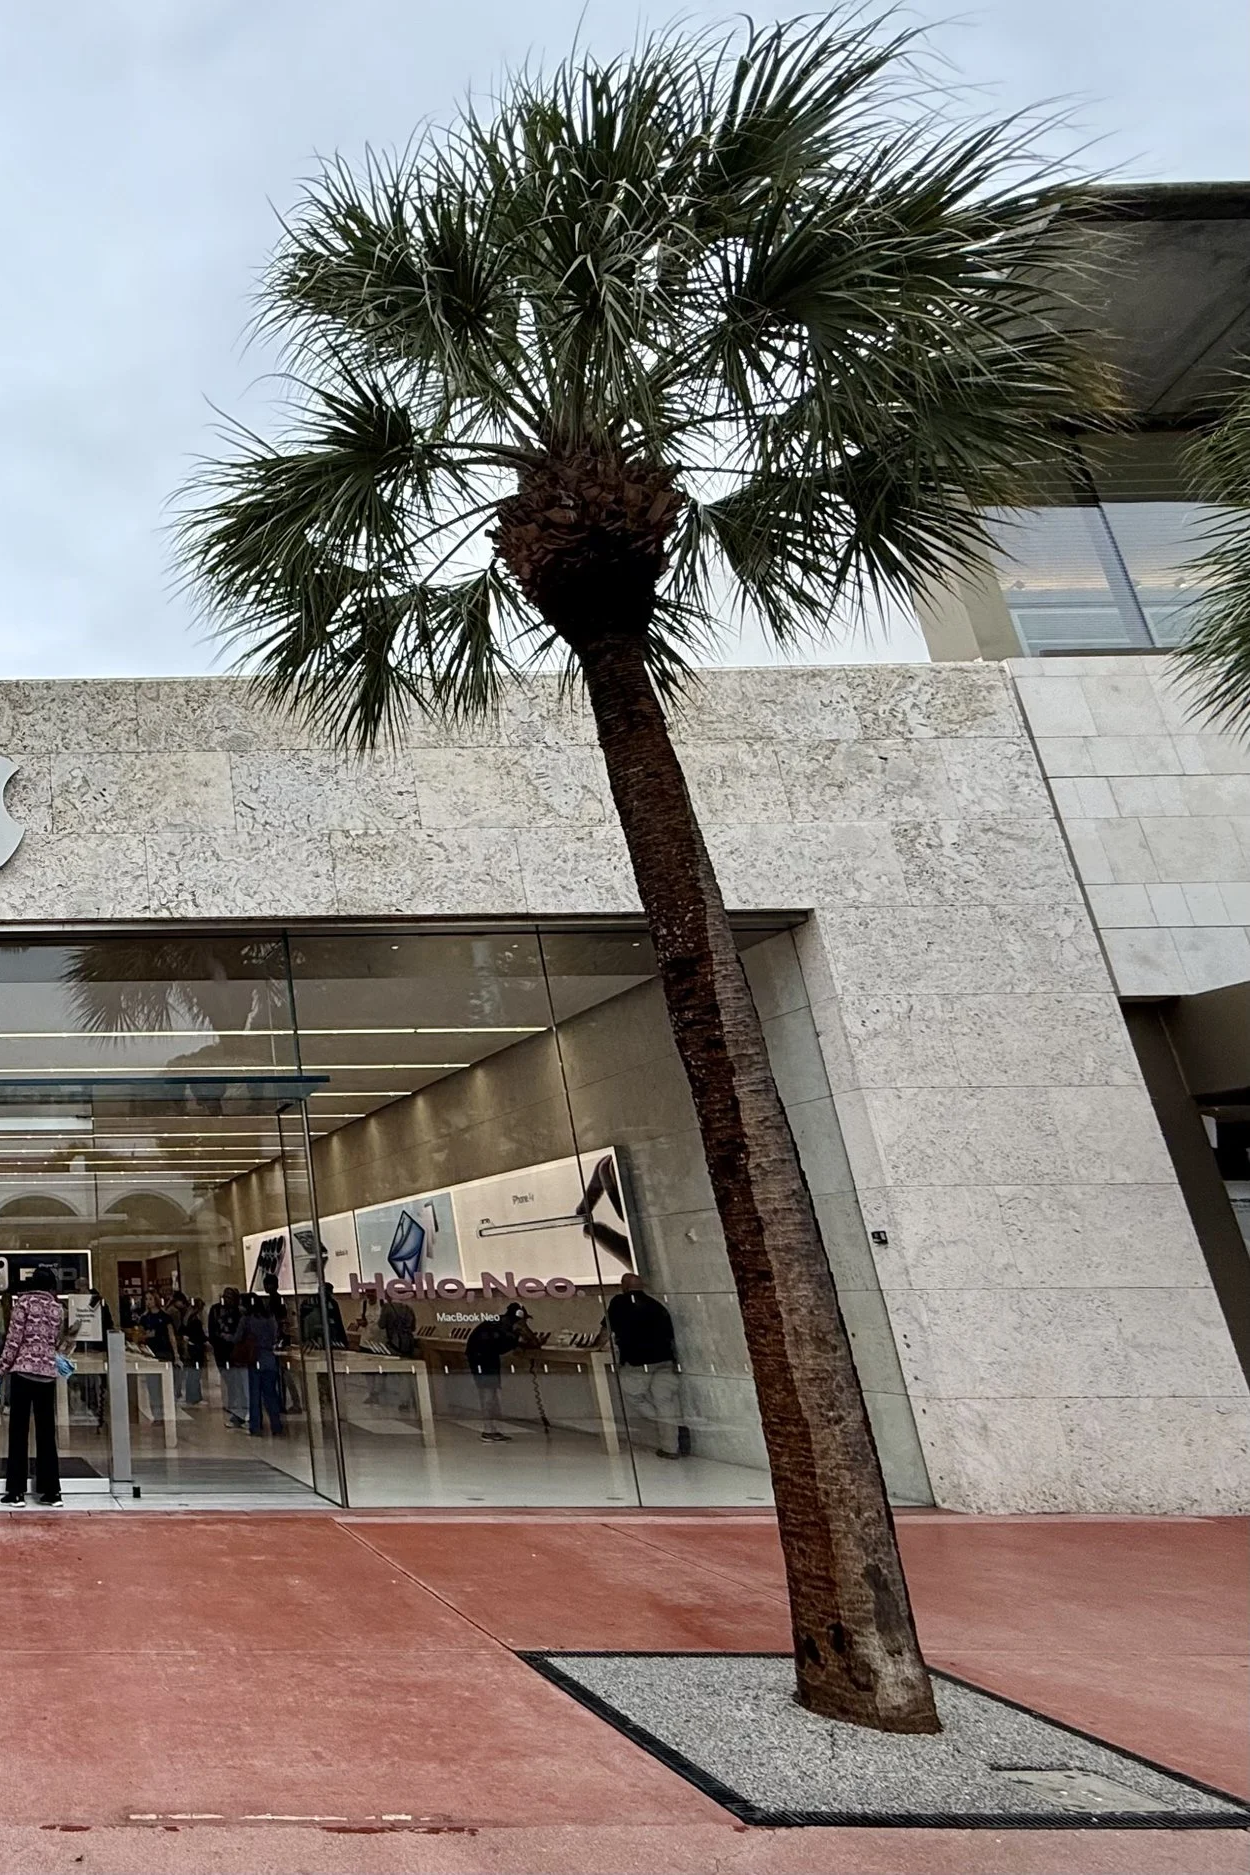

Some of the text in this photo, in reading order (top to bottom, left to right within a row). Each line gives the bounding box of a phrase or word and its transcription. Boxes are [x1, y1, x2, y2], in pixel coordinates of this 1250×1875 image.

[349, 1271, 586, 1303] Hello, Neo.
[436, 1312, 500, 1322] MacBook Neo
